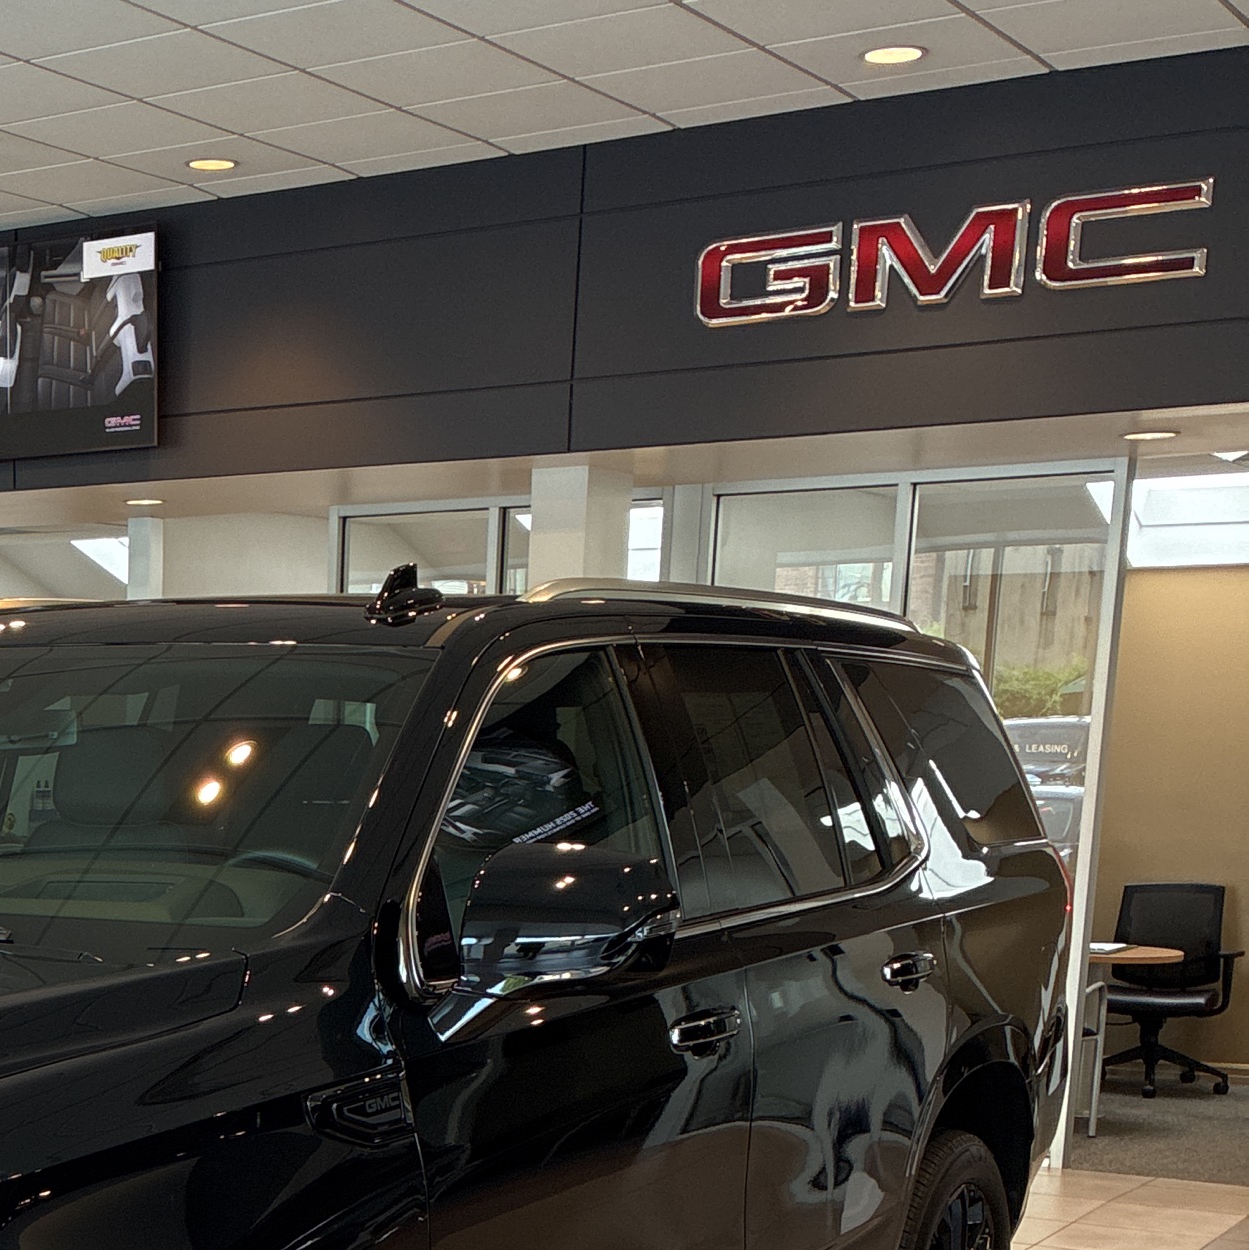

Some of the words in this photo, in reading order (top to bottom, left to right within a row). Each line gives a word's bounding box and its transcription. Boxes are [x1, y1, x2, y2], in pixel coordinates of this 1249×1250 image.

[100, 243, 137, 263] QUALITY
[694, 175, 1216, 328] GMC
[104, 414, 141, 427] GMC
[1026, 743, 1069, 753] LEASING
[365, 1091, 400, 1114] GMC
